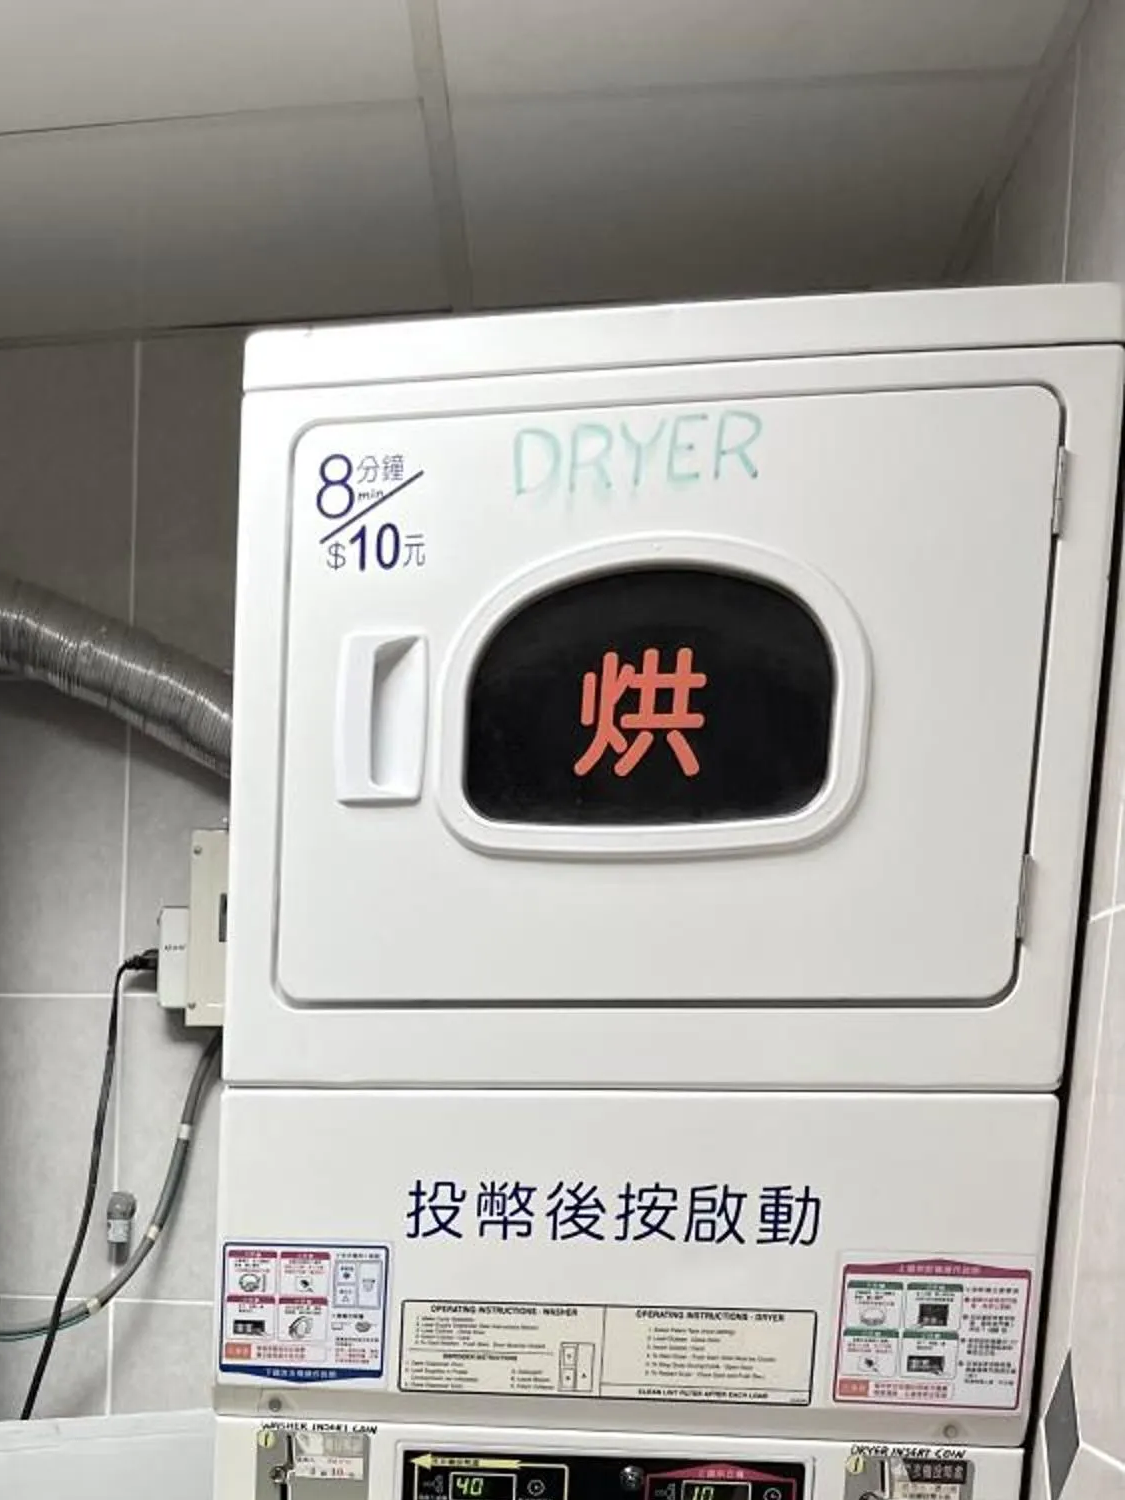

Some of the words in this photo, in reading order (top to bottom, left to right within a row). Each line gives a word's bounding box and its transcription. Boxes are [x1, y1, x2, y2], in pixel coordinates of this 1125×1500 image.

[513, 409, 763, 500] DRYER
[573, 647, 707, 777] 烘
[406, 1180, 822, 1247] 投幣後按啟動
[456, 1477, 484, 1496] 40
